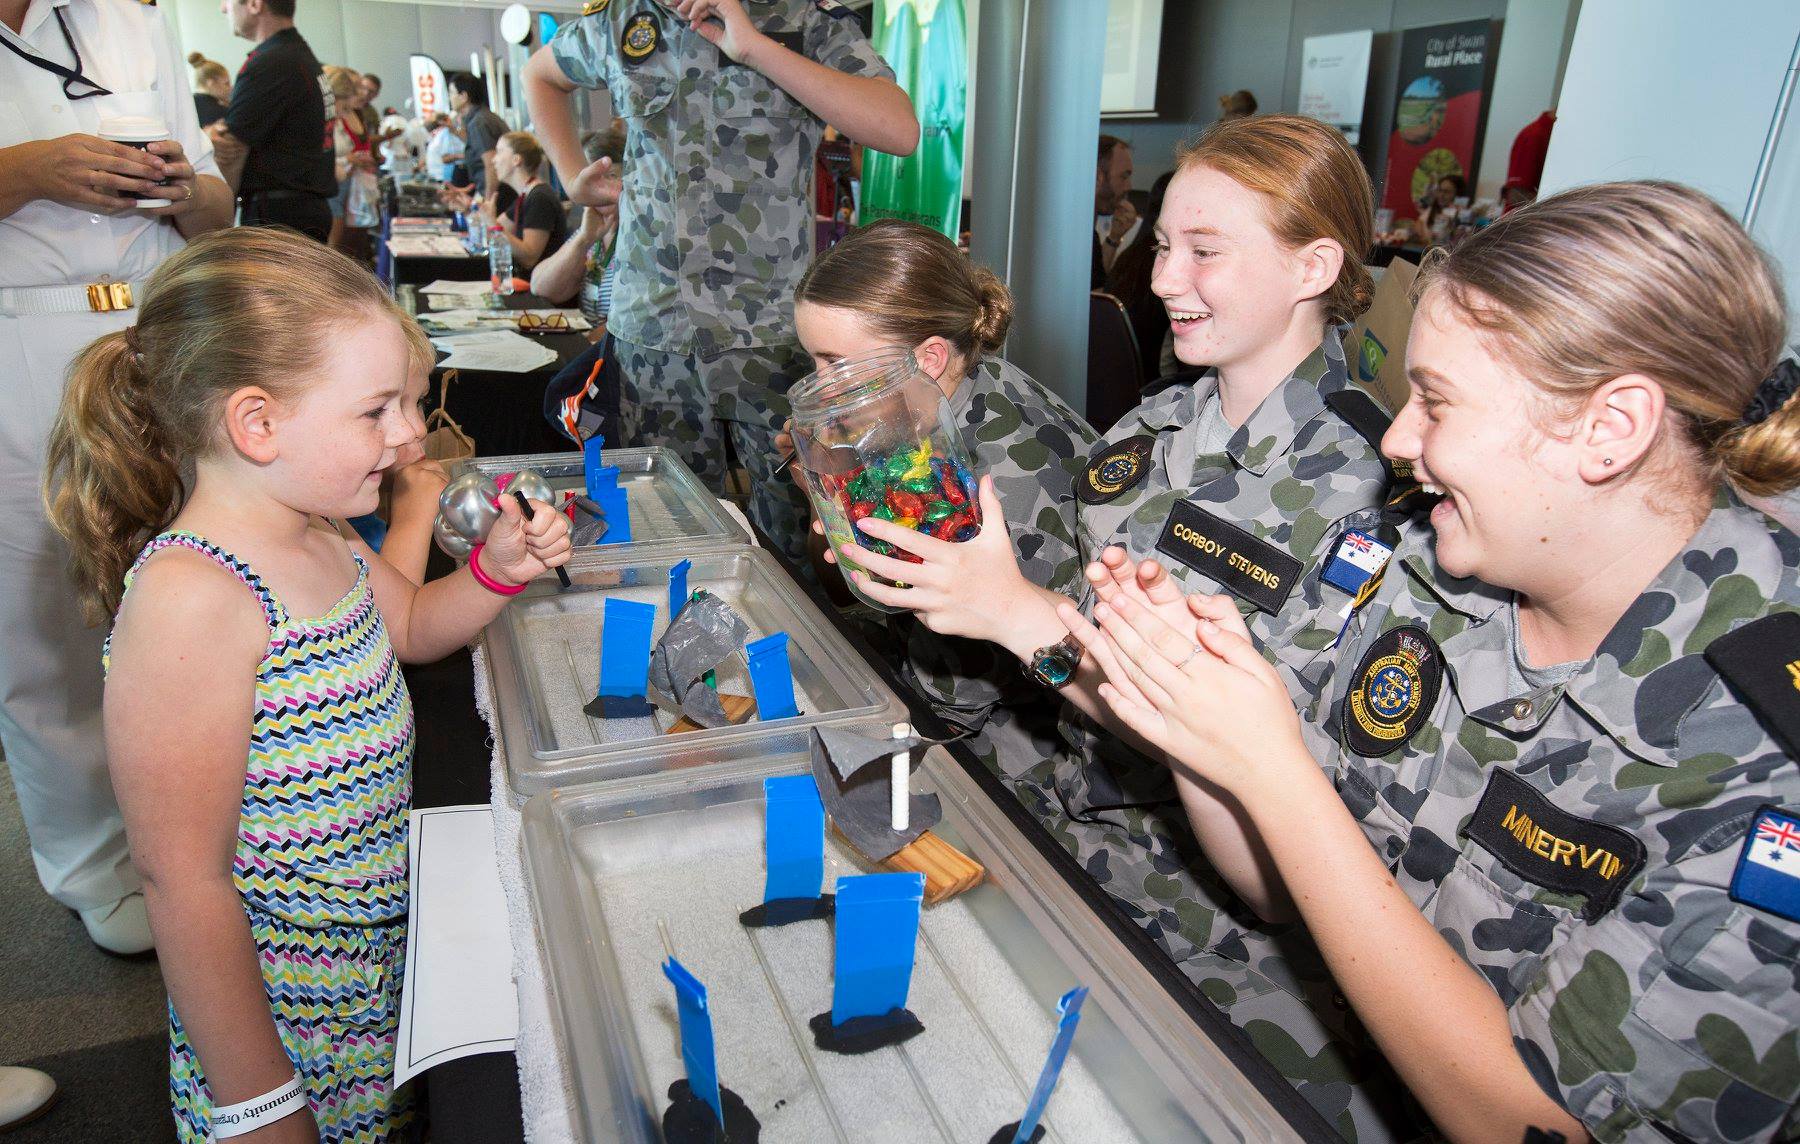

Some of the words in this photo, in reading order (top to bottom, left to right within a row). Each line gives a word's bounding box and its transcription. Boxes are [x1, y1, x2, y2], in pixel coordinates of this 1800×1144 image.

[1426, 38, 1444, 53] City
[1446, 35, 1456, 50] of
[1458, 34, 1485, 49] Swan
[1425, 53, 1451, 68] Rural
[1453, 51, 1482, 66] Place
[1173, 523, 1226, 558] CORBOY
[1228, 552, 1280, 590] STEVENS
